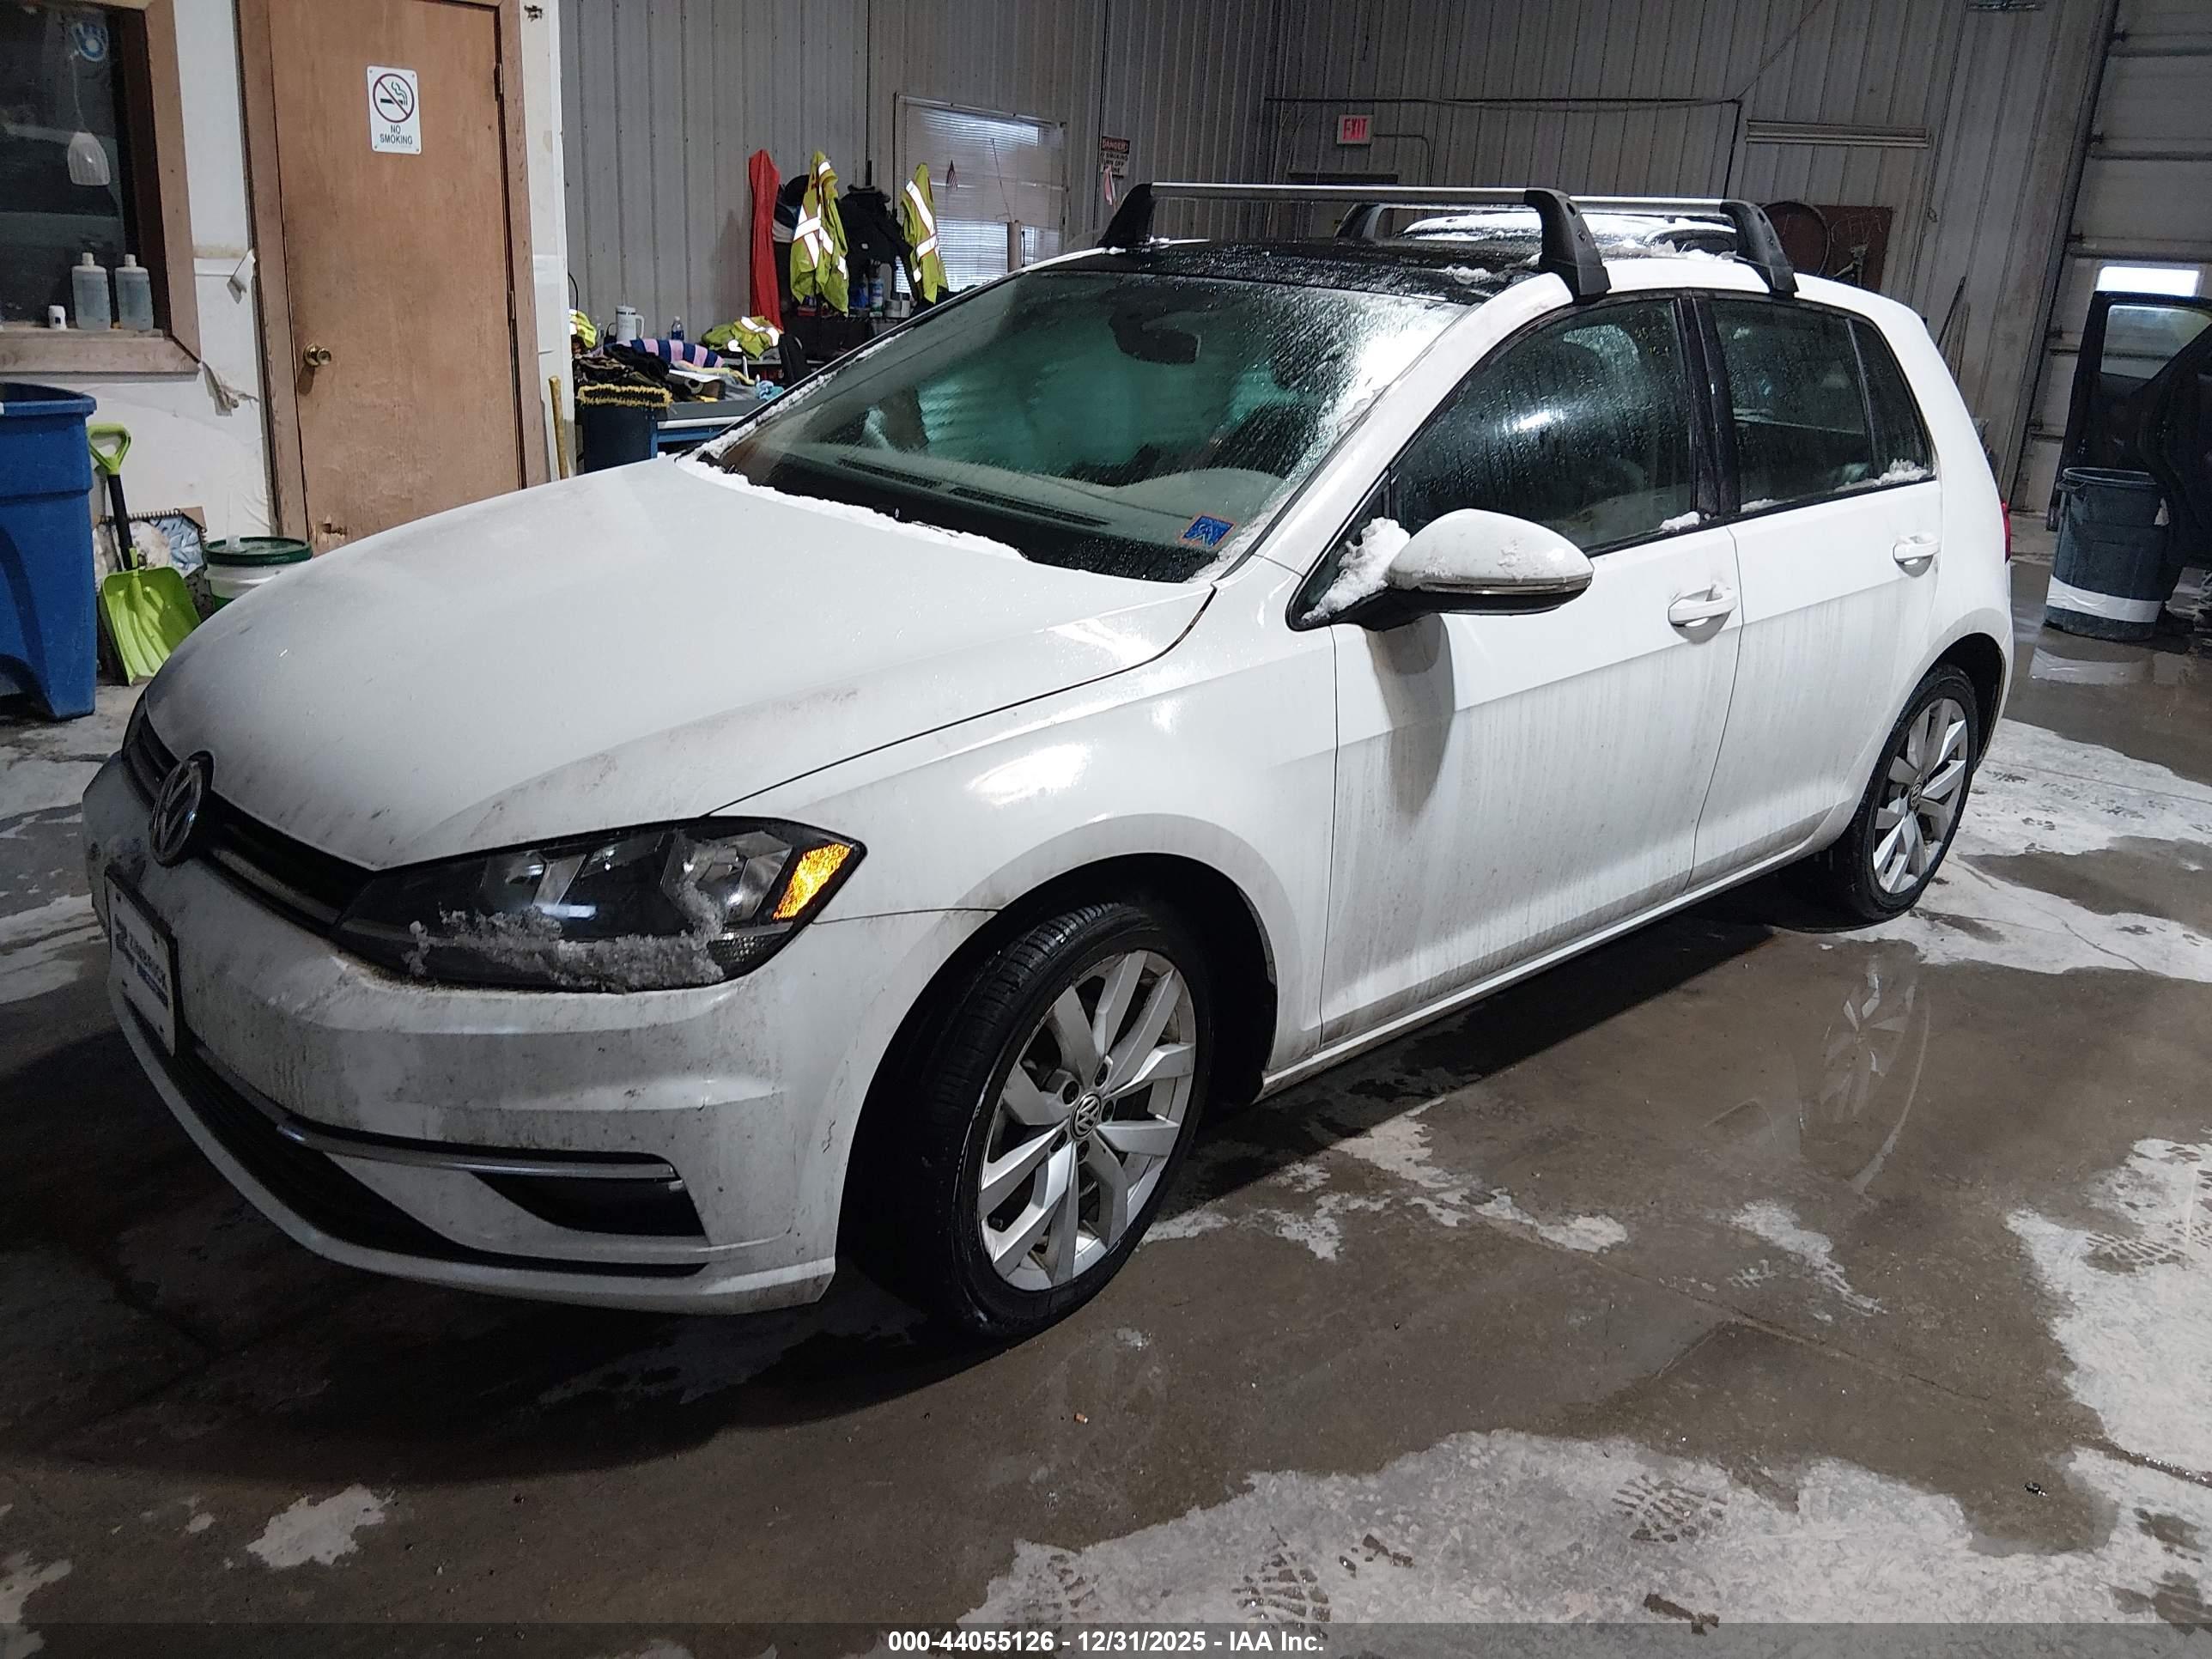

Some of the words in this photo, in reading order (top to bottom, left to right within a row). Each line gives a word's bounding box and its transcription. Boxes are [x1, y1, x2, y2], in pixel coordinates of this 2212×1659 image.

[390, 125, 401, 135] NO
[1342, 118, 1368, 139] EXIT
[380, 133, 413, 145] SMOKING
